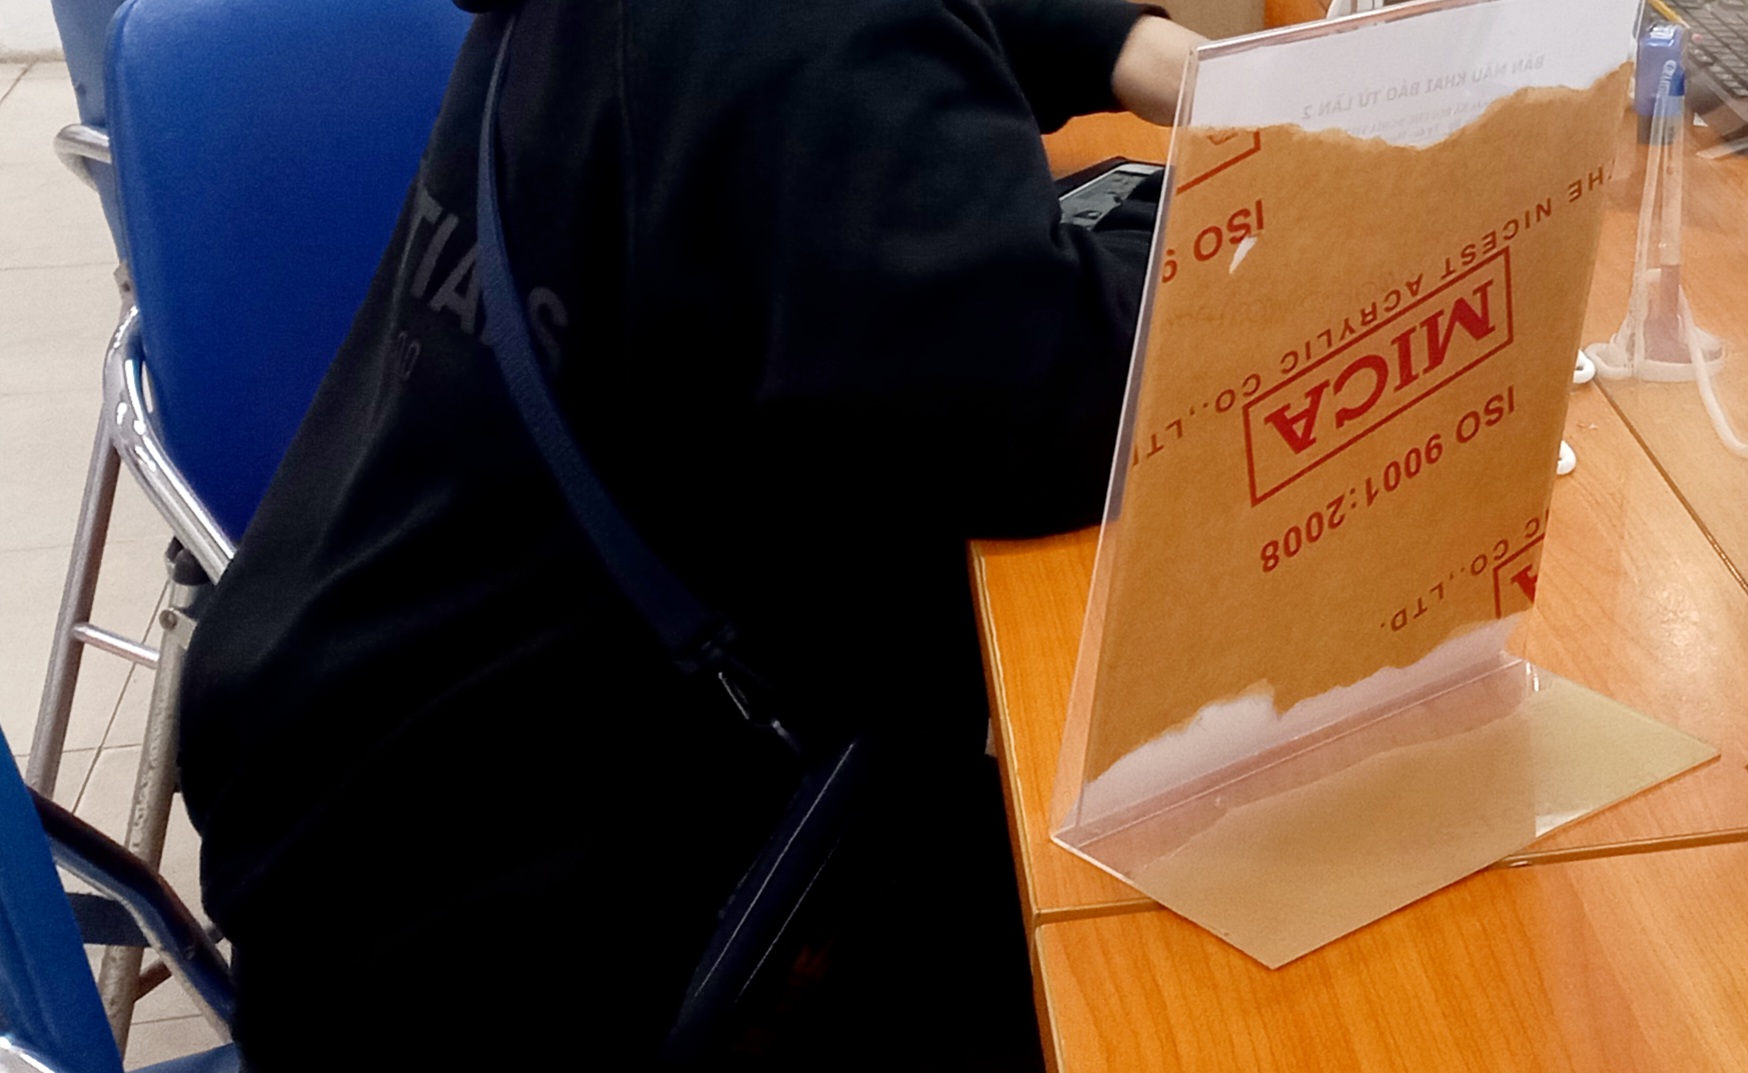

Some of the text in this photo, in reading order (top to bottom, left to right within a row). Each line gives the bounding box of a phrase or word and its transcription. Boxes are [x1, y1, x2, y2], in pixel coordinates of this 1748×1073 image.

[1193, 199, 1264, 262] ISO
[1567, 165, 1614, 204] HE
[1441, 196, 1553, 282] NICEST
[1263, 278, 1497, 455] MICA
[1279, 272, 1424, 373] ACRYLIC
[1260, 385, 1516, 573] ISO 9001:2008
